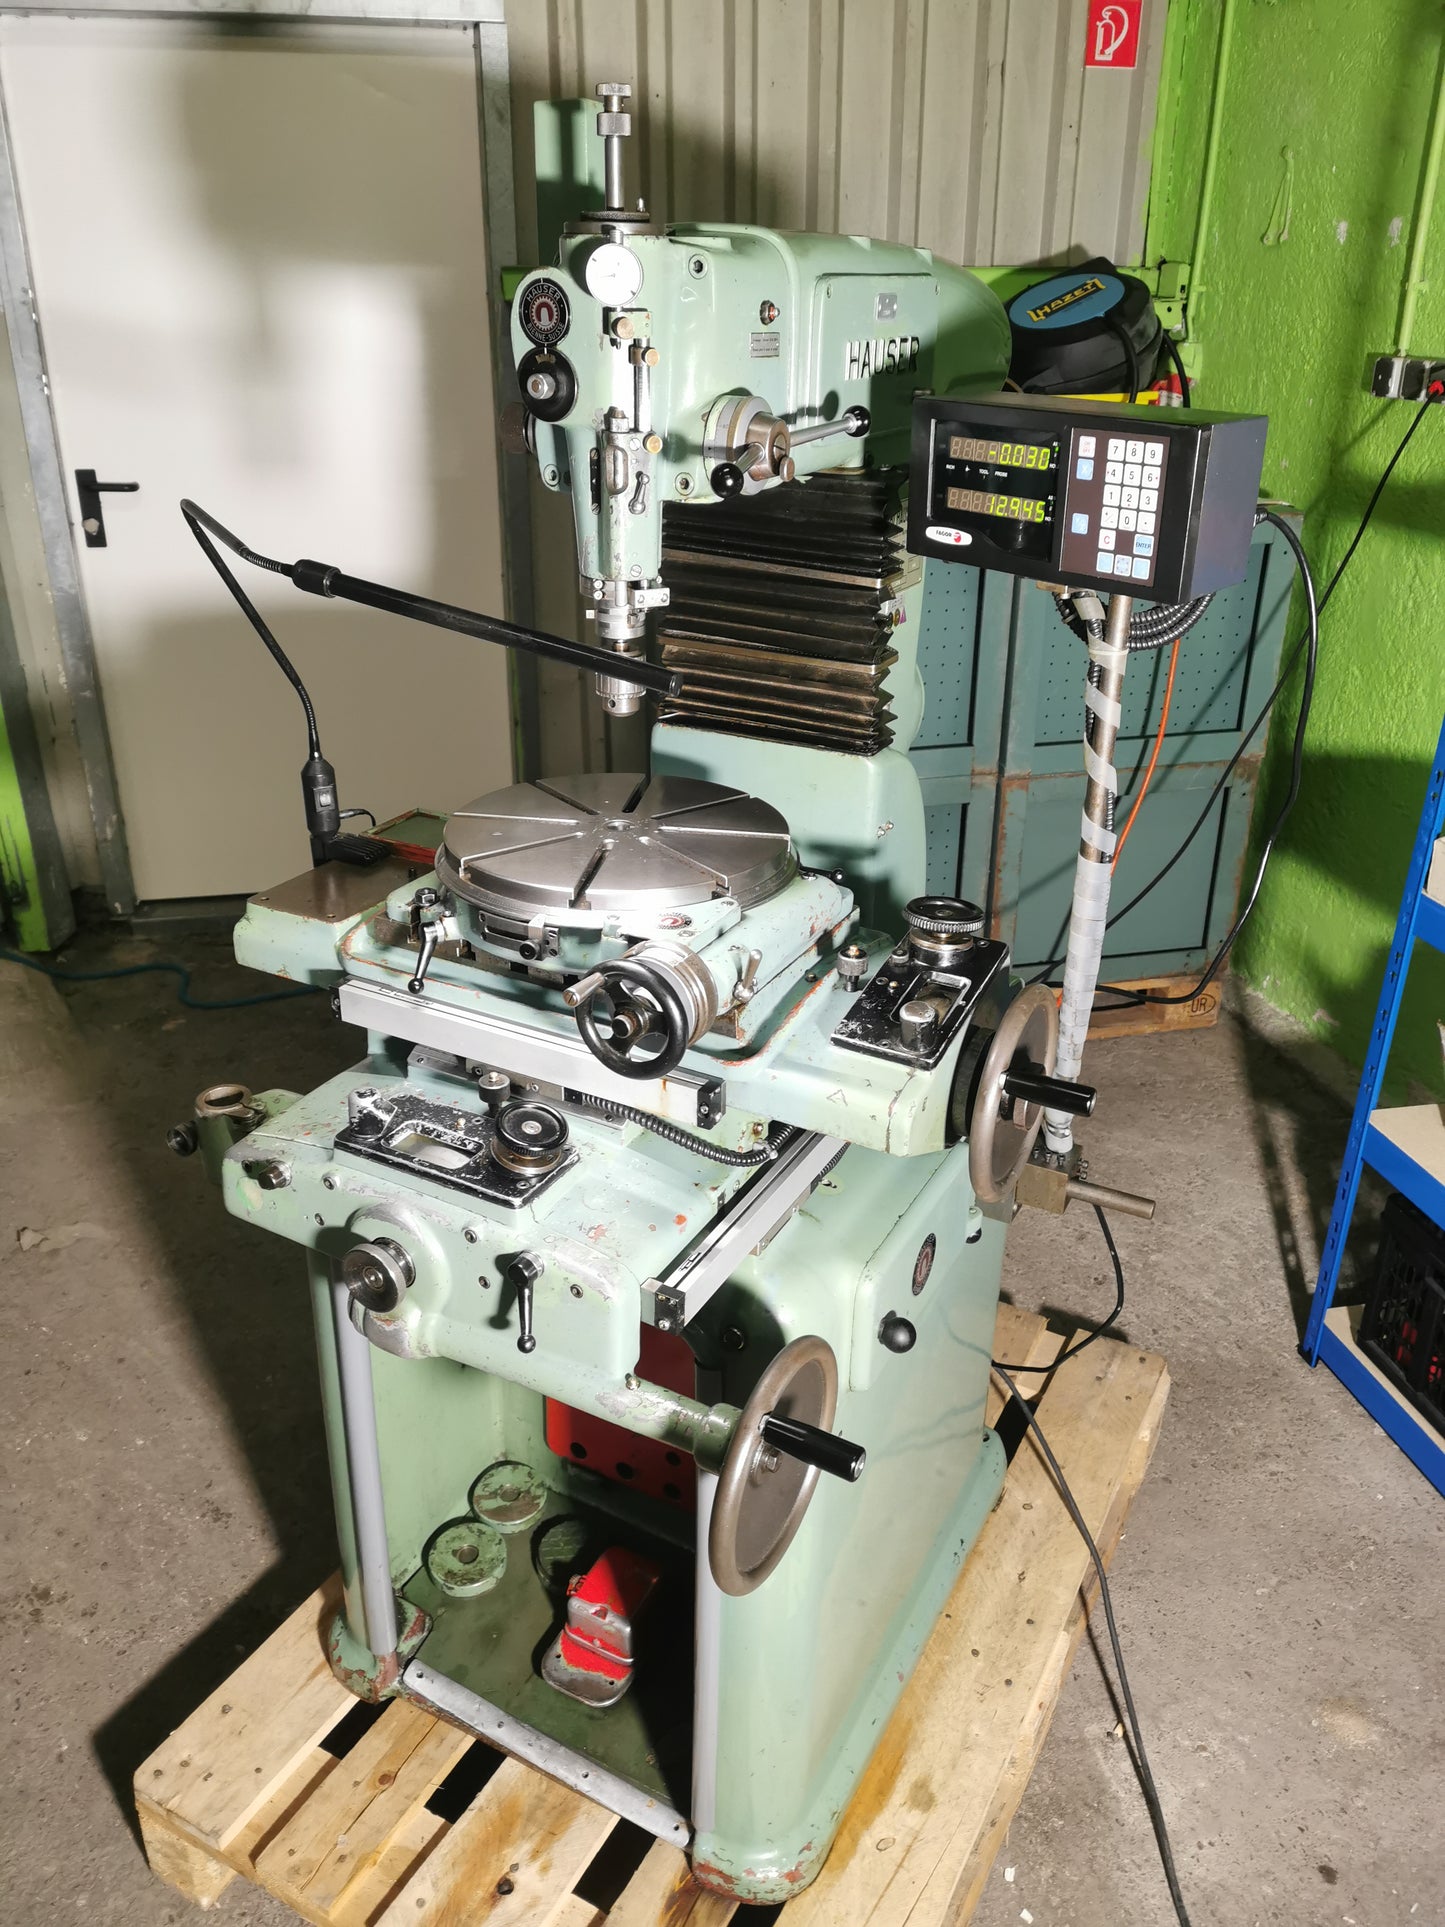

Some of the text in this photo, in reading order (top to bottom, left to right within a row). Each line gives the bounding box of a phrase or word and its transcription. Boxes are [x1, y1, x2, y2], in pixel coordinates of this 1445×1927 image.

[526, 284, 561, 302] HAUSER
[1033, 278, 1100, 319] HAZET
[845, 336, 920, 380] HAUSER
[1113, 445, 1156, 459] 7 8 9
[1110, 468, 1153, 483] 4 5 6
[1126, 493, 1132, 503] 2
[1145, 496, 1151, 506] 3
[1124, 515, 1130, 526] 0
[1103, 535, 1152, 550] C ENTER
[1188, 996, 1208, 1013] UR
